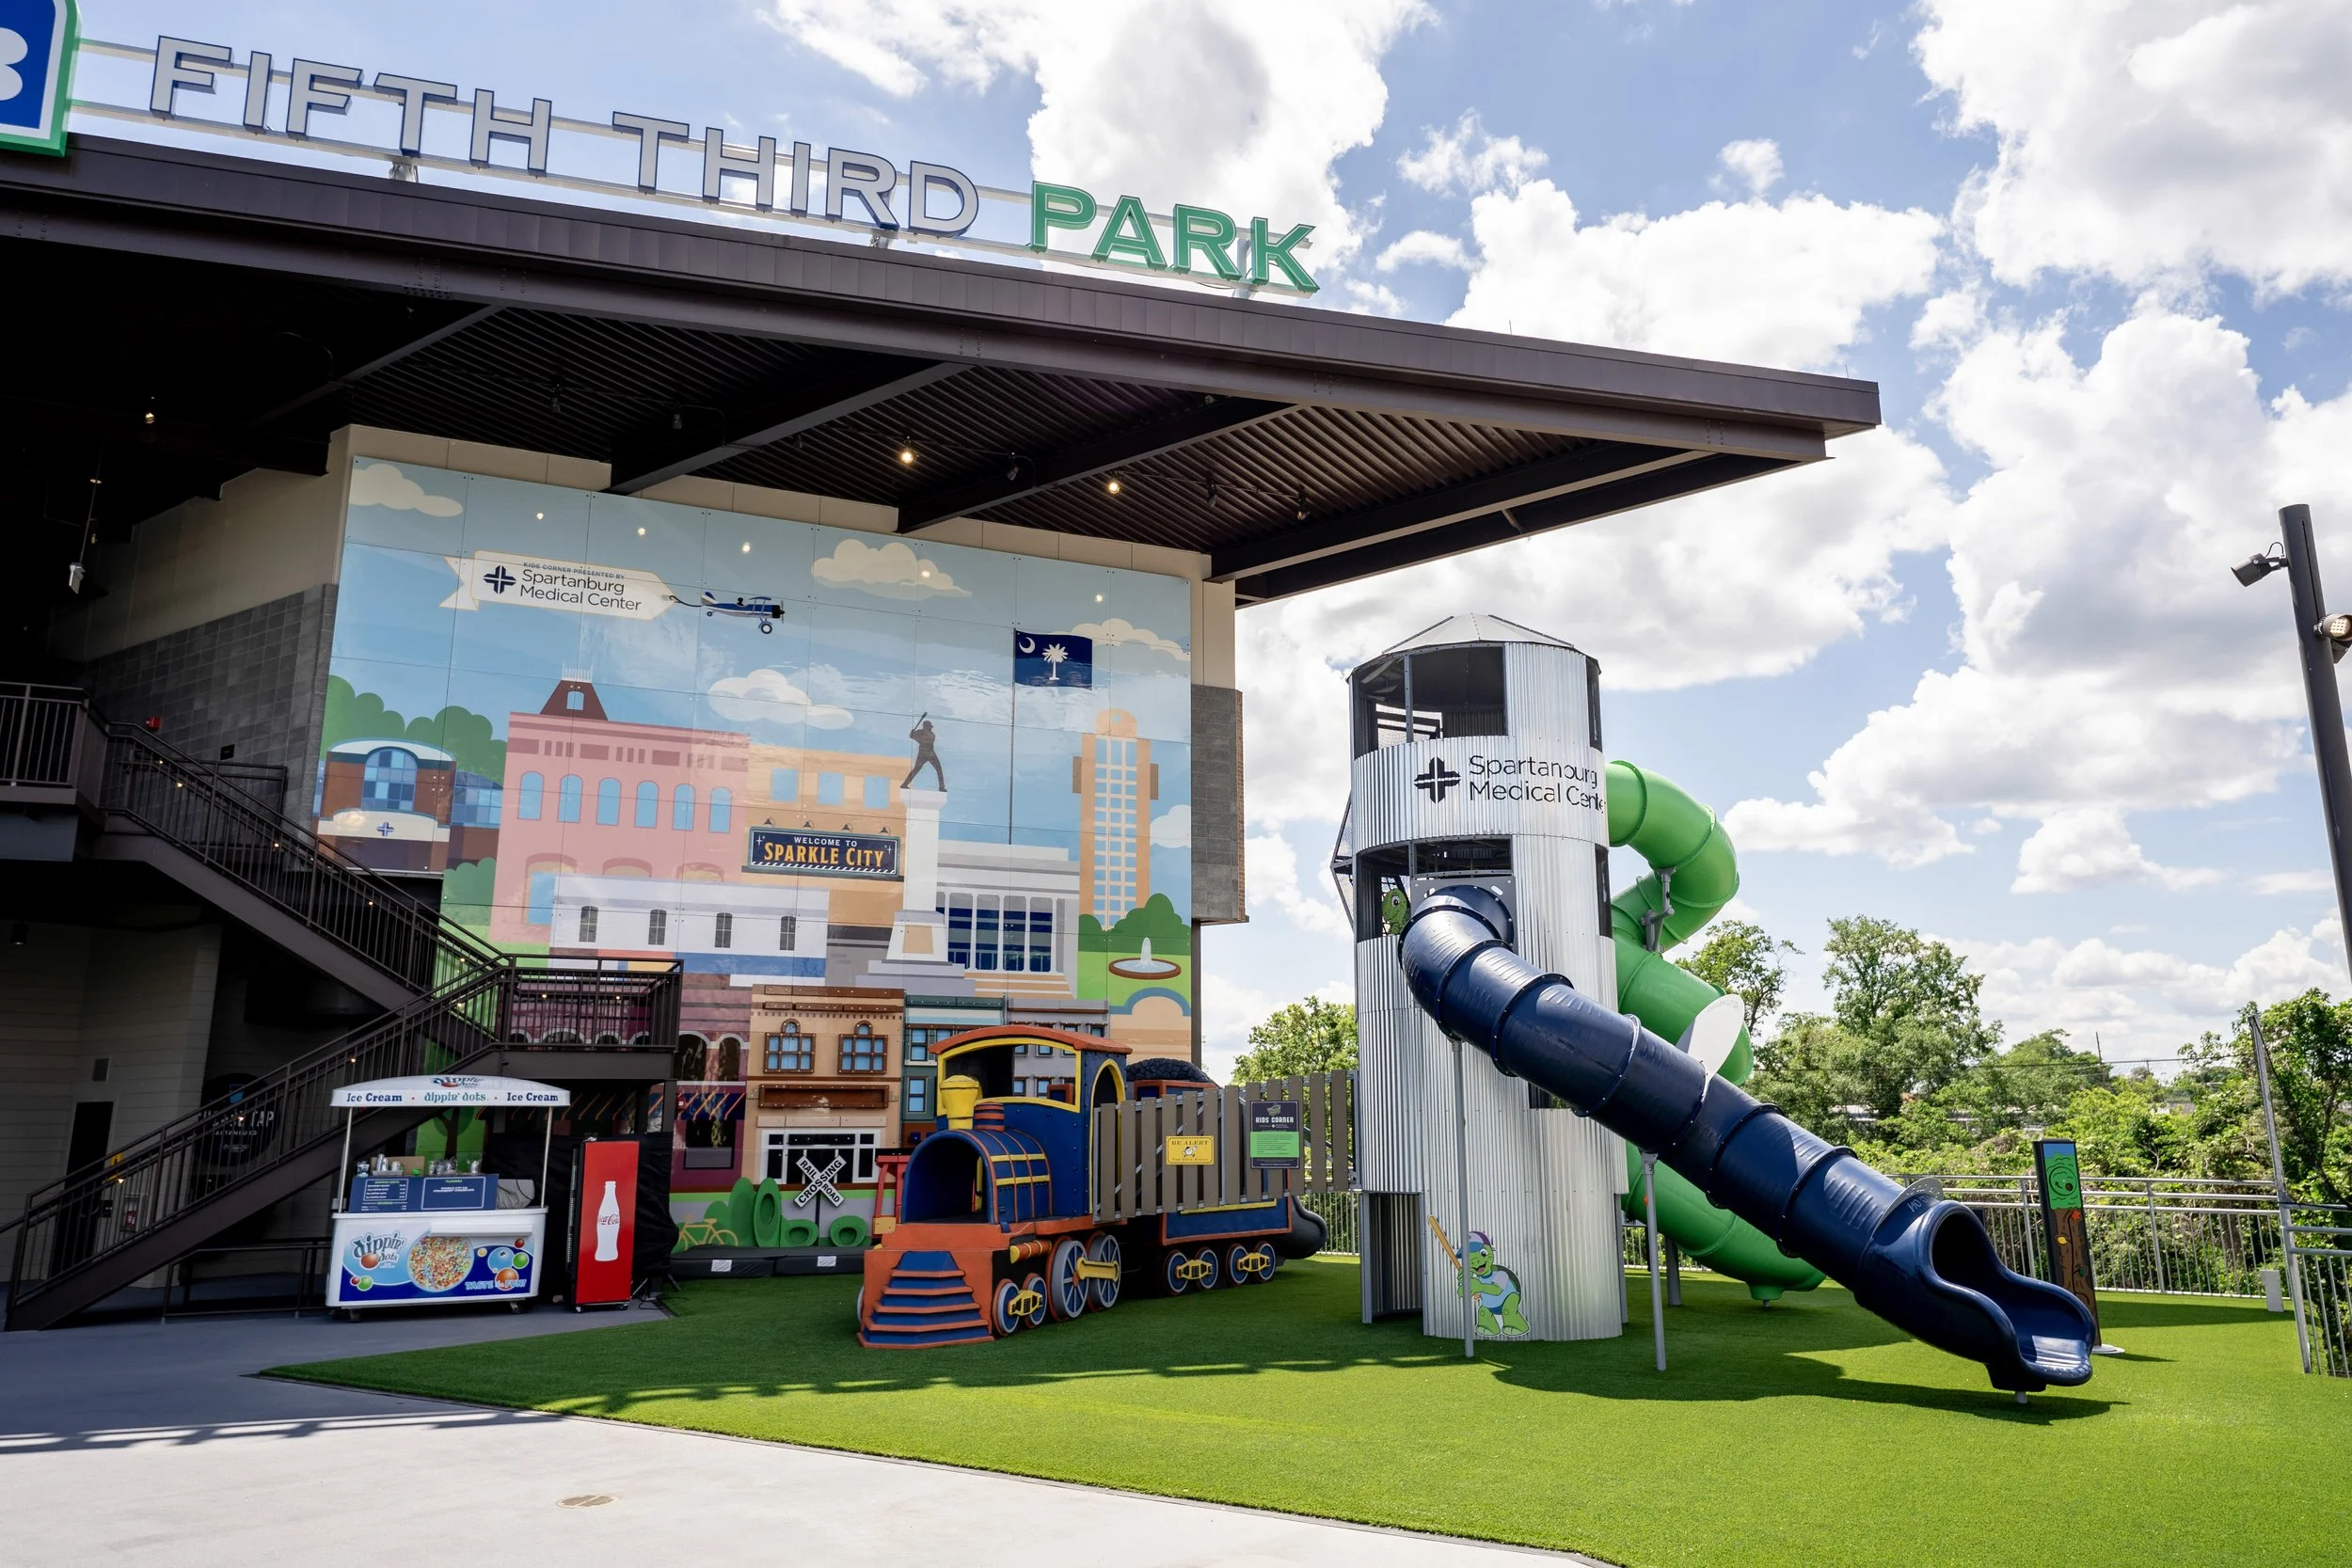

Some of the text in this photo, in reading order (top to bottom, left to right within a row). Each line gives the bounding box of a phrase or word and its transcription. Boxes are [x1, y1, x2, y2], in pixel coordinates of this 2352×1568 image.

[149, 35, 553, 178] FIFTH
[612, 110, 979, 239] THIRD
[1029, 180, 1320, 293] PARK
[521, 568, 625, 595] Spartanburg
[542, 564, 572, 573] CORNER
[573, 568, 614, 578] PRESENTED
[519, 584, 643, 610] Medical Center
[1470, 780, 1562, 802] Medical
[793, 836, 858, 847] WELCOME TO
[763, 842, 884, 867] SPARKLE CITY
[346, 1092, 559, 1103] Ice Cream dippin' dots Ice Cream
[799, 1159, 818, 1180] RAIL
[798, 1160, 843, 1204] CROSSING
[821, 1183, 840, 1203] ROAD
[378, 1252, 398, 1262] dots
[465, 1280, 494, 1291] TASTE
